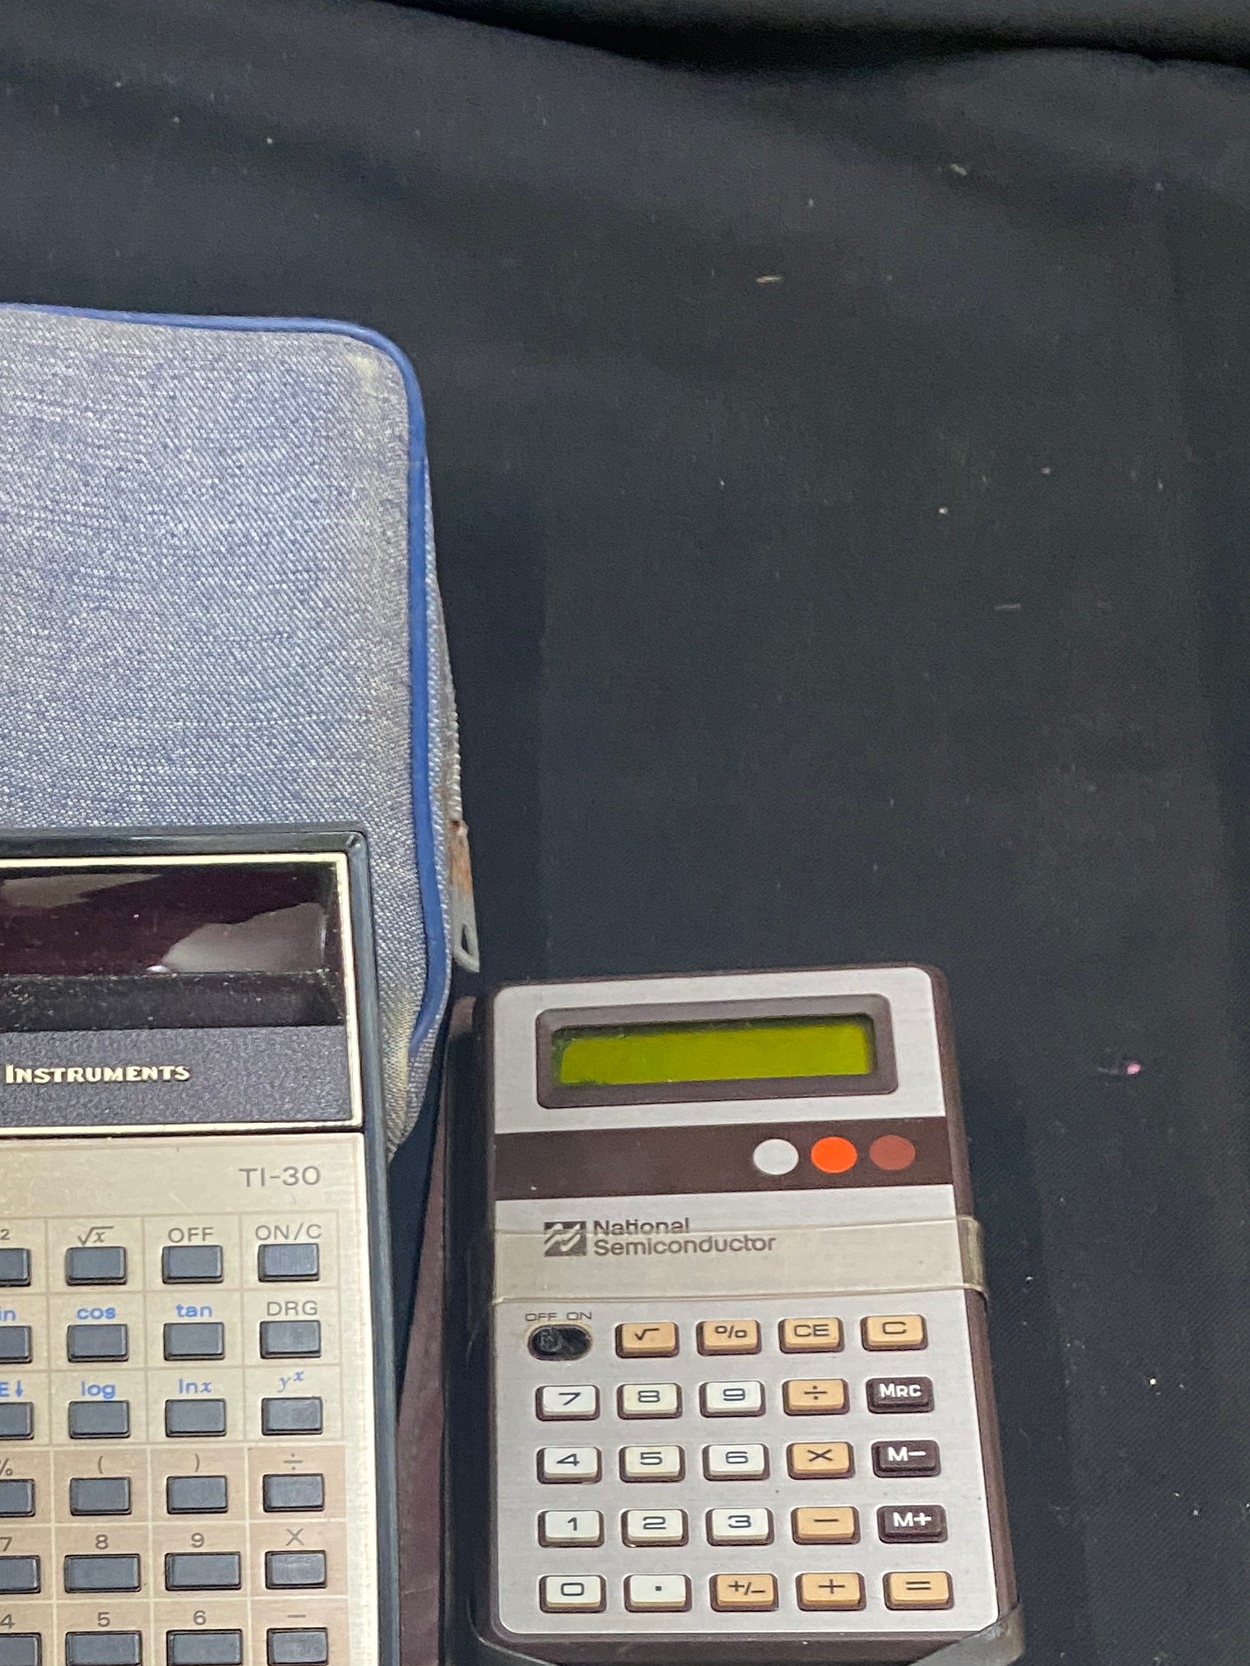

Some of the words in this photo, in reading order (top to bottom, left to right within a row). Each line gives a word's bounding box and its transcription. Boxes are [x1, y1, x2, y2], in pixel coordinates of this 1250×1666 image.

[5, 1063, 190, 1085] INSTRUMENTS
[239, 1166, 321, 1188] TI-30
[255, 1222, 322, 1241] ON/C
[593, 1217, 690, 1236] National
[168, 1227, 214, 1243] OFF
[593, 1234, 776, 1257] Semiconductor
[76, 1306, 116, 1321] cos
[176, 1304, 213, 1318] tan
[266, 1300, 318, 1316] DRG
[525, 1312, 557, 1322] OFF
[566, 1311, 593, 1321] ON
[794, 1323, 830, 1338] CE
[882, 1321, 907, 1335] C
[81, 1381, 116, 1399] log
[637, 1390, 661, 1403] 8
[723, 1388, 746, 1402] 9
[558, 1392, 582, 1406] 7
[556, 1453, 580, 1467] 4
[640, 1451, 663, 1466] 5
[725, 1451, 749, 1465] 6
[567, 1517, 578, 1531] 1
[643, 1515, 667, 1530] 2
[728, 1514, 752, 1529] 3
[893, 1512, 932, 1527] M+
[0, 1537, 13, 1552] 7
[95, 1534, 109, 1550] 8
[191, 1533, 205, 1549] 9
[560, 1582, 585, 1596] 0
[0, 1614, 15, 1629] 4
[97, 1612, 111, 1627] 5
[193, 1610, 207, 1625] 6
